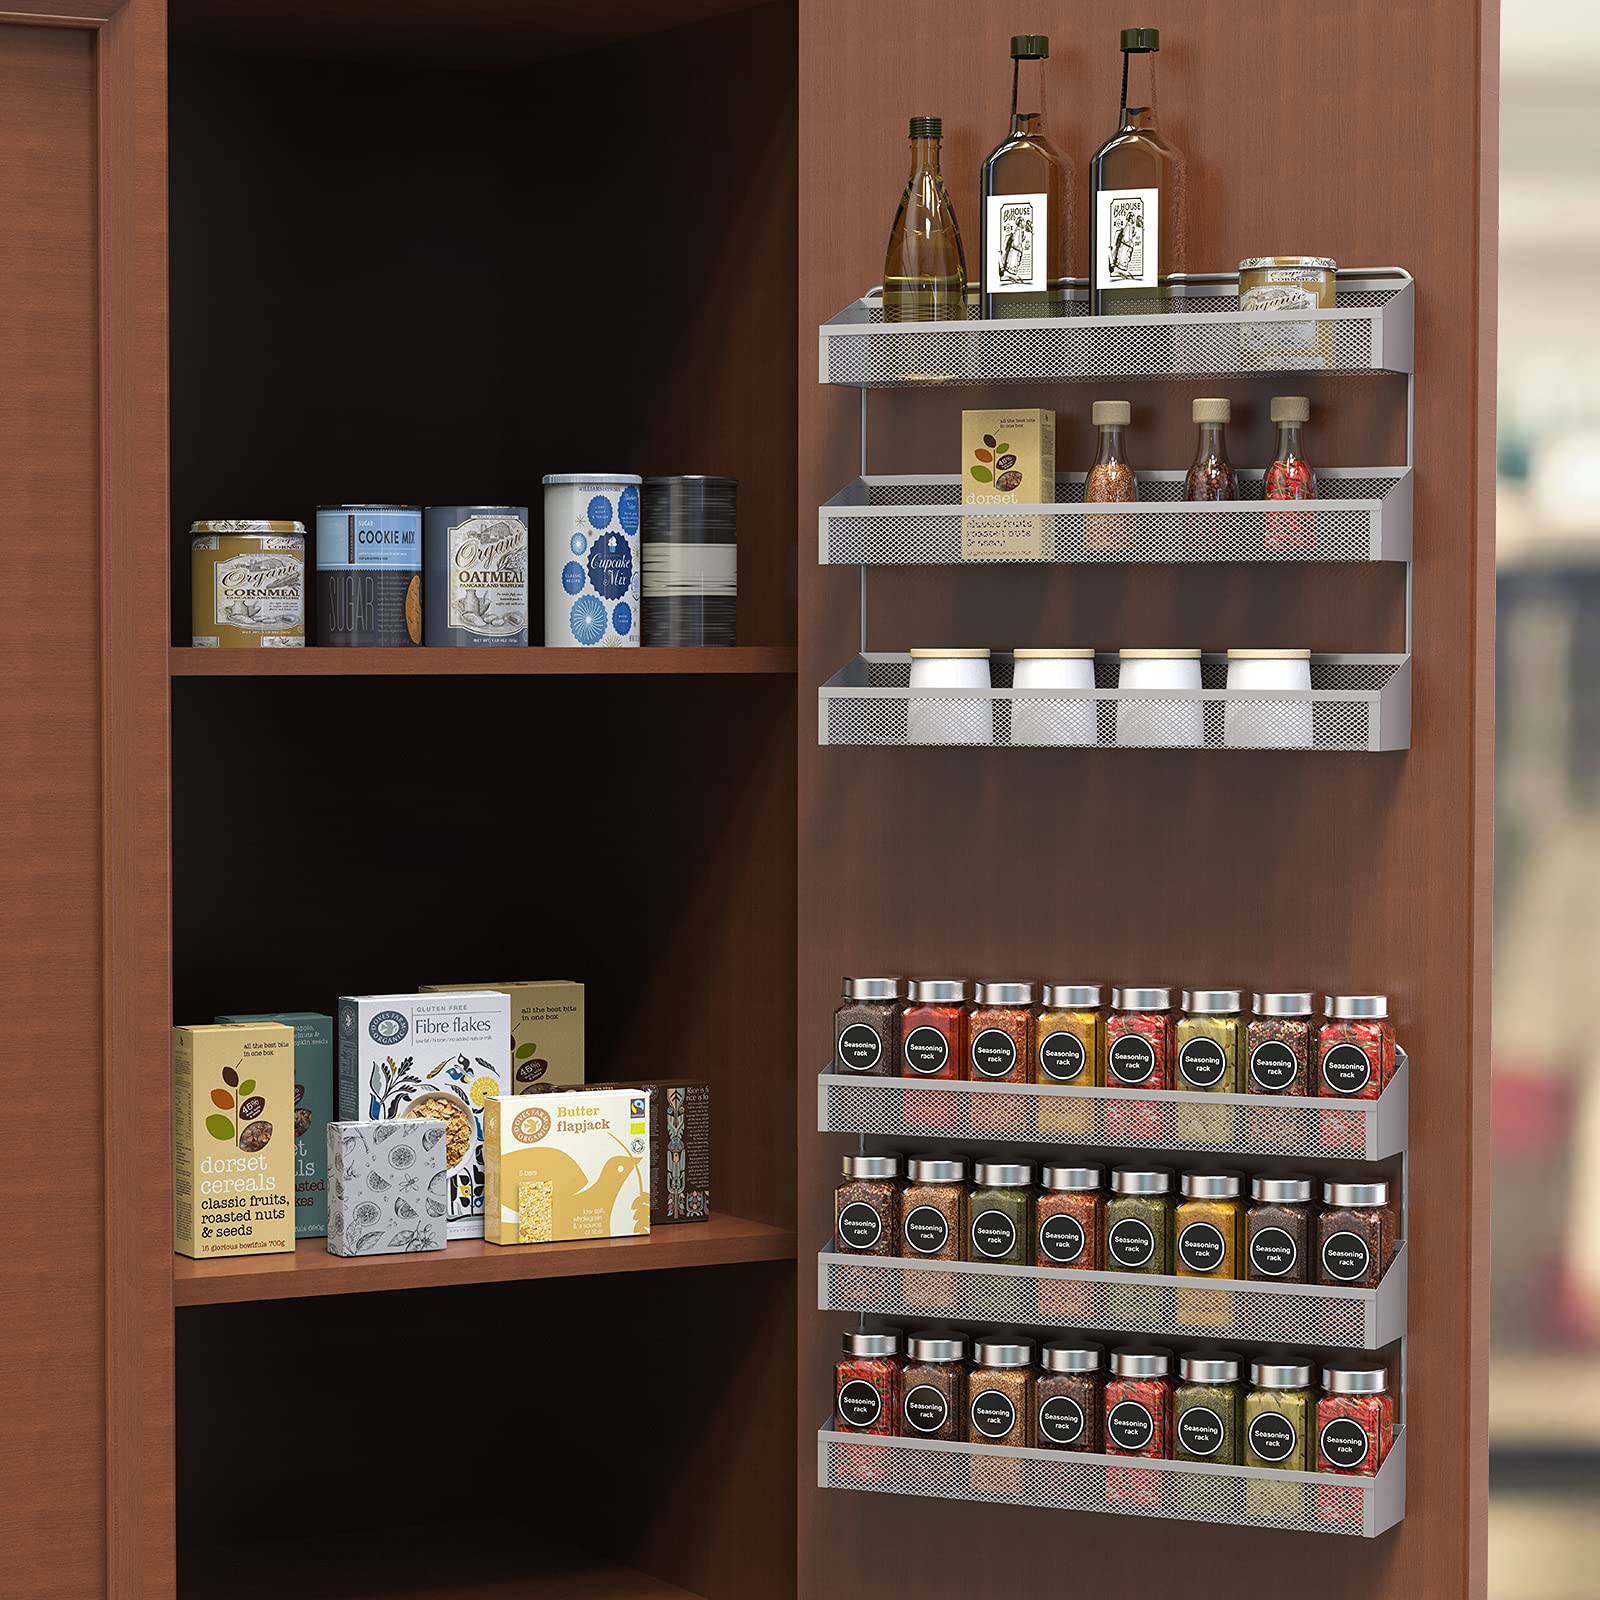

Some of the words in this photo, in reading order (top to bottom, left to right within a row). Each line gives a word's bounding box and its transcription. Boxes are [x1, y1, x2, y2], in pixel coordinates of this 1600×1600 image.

[966, 492, 1018, 504] dorset
[358, 530, 399, 544] COOKIE
[402, 531, 415, 544] MIX
[455, 530, 524, 570] Organic
[590, 553, 630, 572] Cupcake
[222, 562, 298, 587] Organic
[460, 570, 524, 582] OATMEAL
[602, 570, 626, 586] Mix
[328, 576, 374, 632] SUGAR
[416, 1018, 450, 1034] Fibre
[453, 1017, 491, 1032] flakes
[373, 1031, 405, 1044] ORGANIC
[844, 1041, 876, 1050] Seasoning
[910, 1044, 942, 1052] Seasoning
[978, 1047, 1010, 1056] Seasoning
[1046, 1050, 1079, 1058] Seasoning
[1115, 1053, 1149, 1062] Seasoning
[1185, 1056, 1220, 1065] Seasoning
[1257, 1059, 1291, 1068] Seasoning
[1329, 1062, 1364, 1071] Seasoning
[557, 1106, 599, 1117] Butter
[557, 1119, 610, 1133] flapjack
[517, 1125, 549, 1142] ORGANIC
[200, 1154, 268, 1174] dorset
[200, 1174, 276, 1195] cereals
[201, 1196, 246, 1210] classic
[250, 1194, 290, 1206] fruits,
[201, 1210, 251, 1224] roasted
[255, 1209, 285, 1220] nuts
[844, 1219, 876, 1228] Seasoning
[910, 1224, 942, 1232] Seasoning
[202, 1227, 213, 1238] &
[216, 1225, 252, 1237] seeds
[978, 1228, 1010, 1237] Seasoning
[1046, 1232, 1078, 1241] Seasoning
[1115, 1236, 1148, 1246] Seasoning
[1185, 1241, 1219, 1250] Seasoning
[211, 1244, 238, 1252] glorious
[1256, 1245, 1290, 1254] Seasoning
[1328, 1250, 1363, 1259] Seasoning
[844, 1397, 875, 1406] Seasoning
[910, 1402, 942, 1412] Seasoning
[977, 1408, 1009, 1417] Seasoning
[1045, 1413, 1078, 1423] Seasoning
[1114, 1419, 1147, 1428] Seasoning
[1184, 1425, 1218, 1434] Seasoning
[1255, 1430, 1289, 1440] Seasoning
[1327, 1436, 1362, 1446] Seasoning
